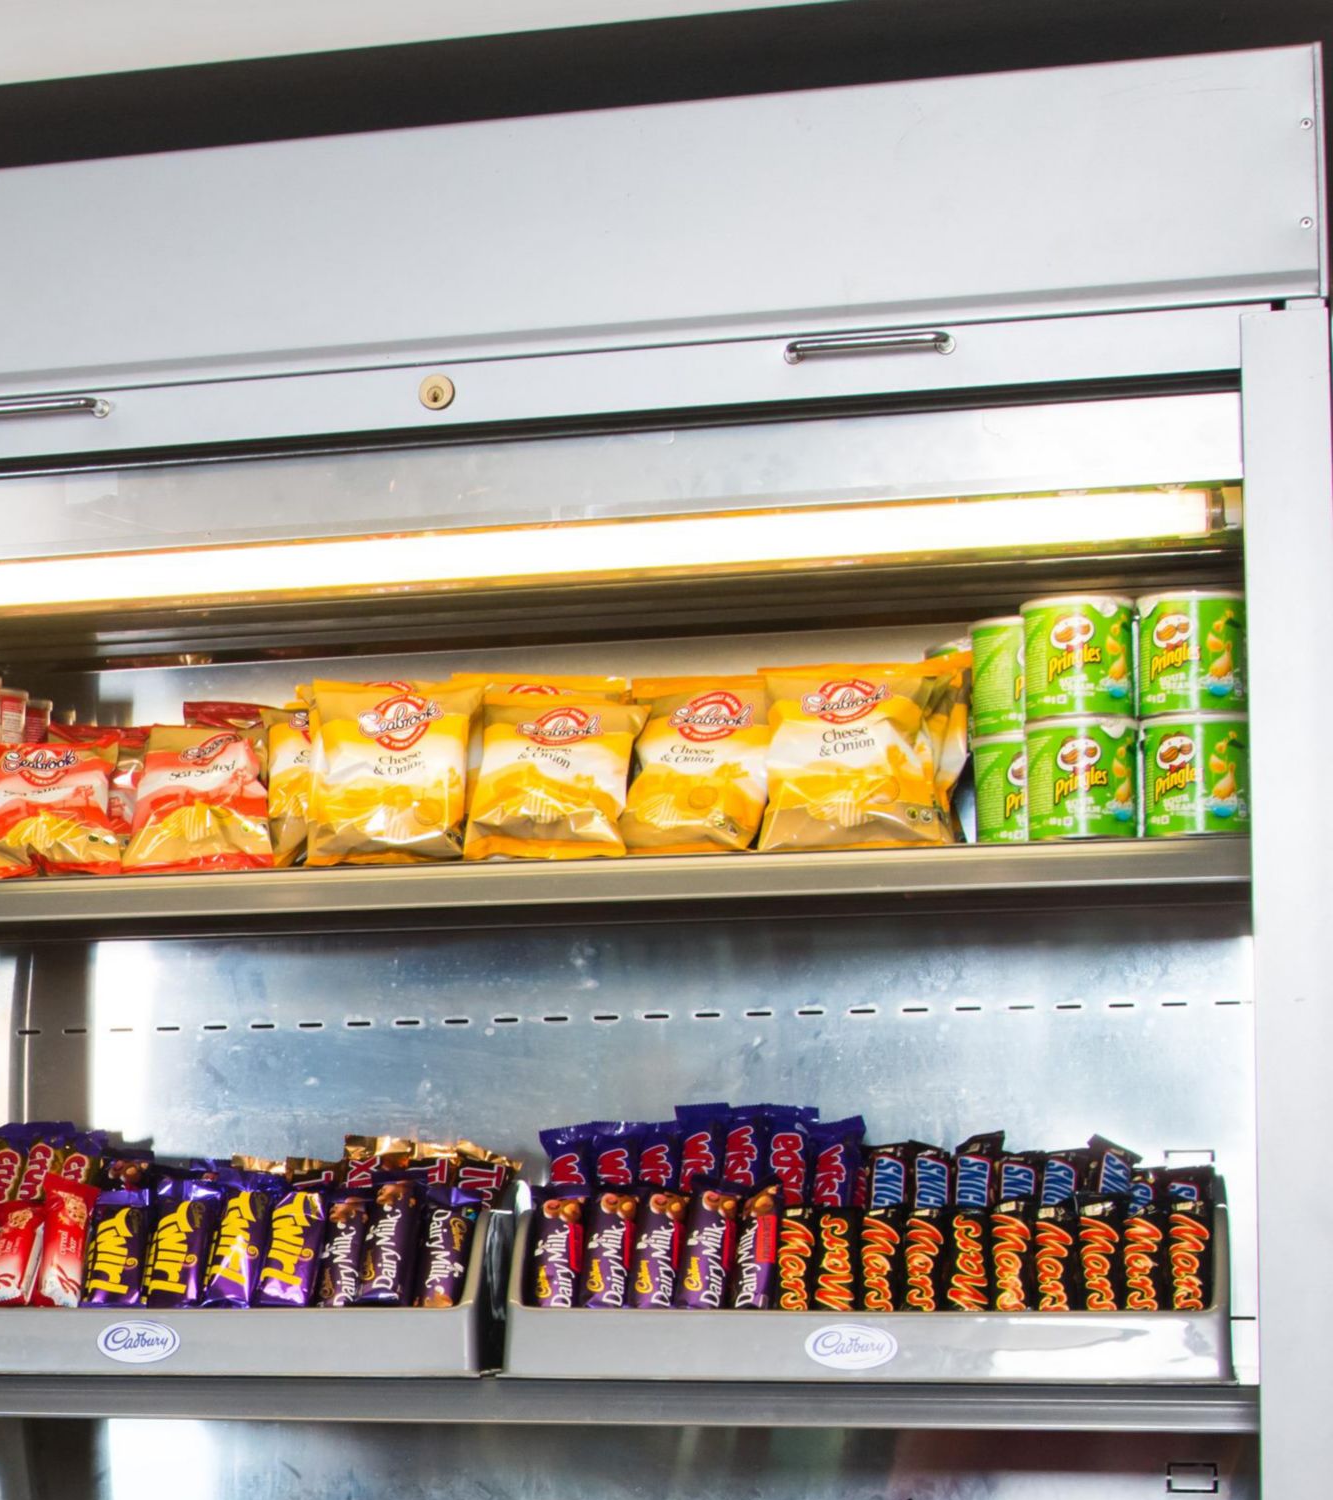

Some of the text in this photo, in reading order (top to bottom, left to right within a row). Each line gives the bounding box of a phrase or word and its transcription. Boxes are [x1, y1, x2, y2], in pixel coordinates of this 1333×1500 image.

[802, 683, 890, 716] Seabrook
[1049, 643, 1101, 682] Prinles
[359, 701, 443, 737] Seabrook
[669, 703, 753, 727] Seabrook
[819, 737, 876, 757] & Onion
[822, 726, 868, 743] Cheese
[2, 750, 78, 774] Seabrook
[1055, 766, 1108, 805] Prigles
[88, 1207, 138, 1294] Twirl
[148, 1201, 197, 1294] Twirl
[211, 1191, 259, 1286] Twirl
[260, 1191, 314, 1286] Twirl
[333, 1226, 359, 1306] Dairy Milk
[372, 1208, 402, 1290] Dairy Milk
[425, 1250, 451, 1288] Milk
[426, 1208, 452, 1250] Dairy
[546, 1224, 575, 1308] Dairy Milk
[601, 1221, 627, 1307] Dairy Milk
[649, 1221, 676, 1307] Dairy Milk
[700, 1219, 727, 1307] Dairy Milk
[735, 1220, 761, 1308] Dairy Milk
[778, 1218, 816, 1310] Mars
[815, 1214, 854, 1311] Mars
[861, 1216, 900, 1311] Mars
[906, 1218, 944, 1311] Mars
[948, 1215, 988, 1311] Mars
[991, 1214, 1030, 1311] Mars
[1036, 1221, 1073, 1311] Mars
[1080, 1216, 1119, 1311] Mars
[1124, 1217, 1163, 1311] Mars
[1169, 1213, 1209, 1311] Mars
[104, 1327, 169, 1352] Cadbury
[813, 1330, 885, 1357] Cadbury
